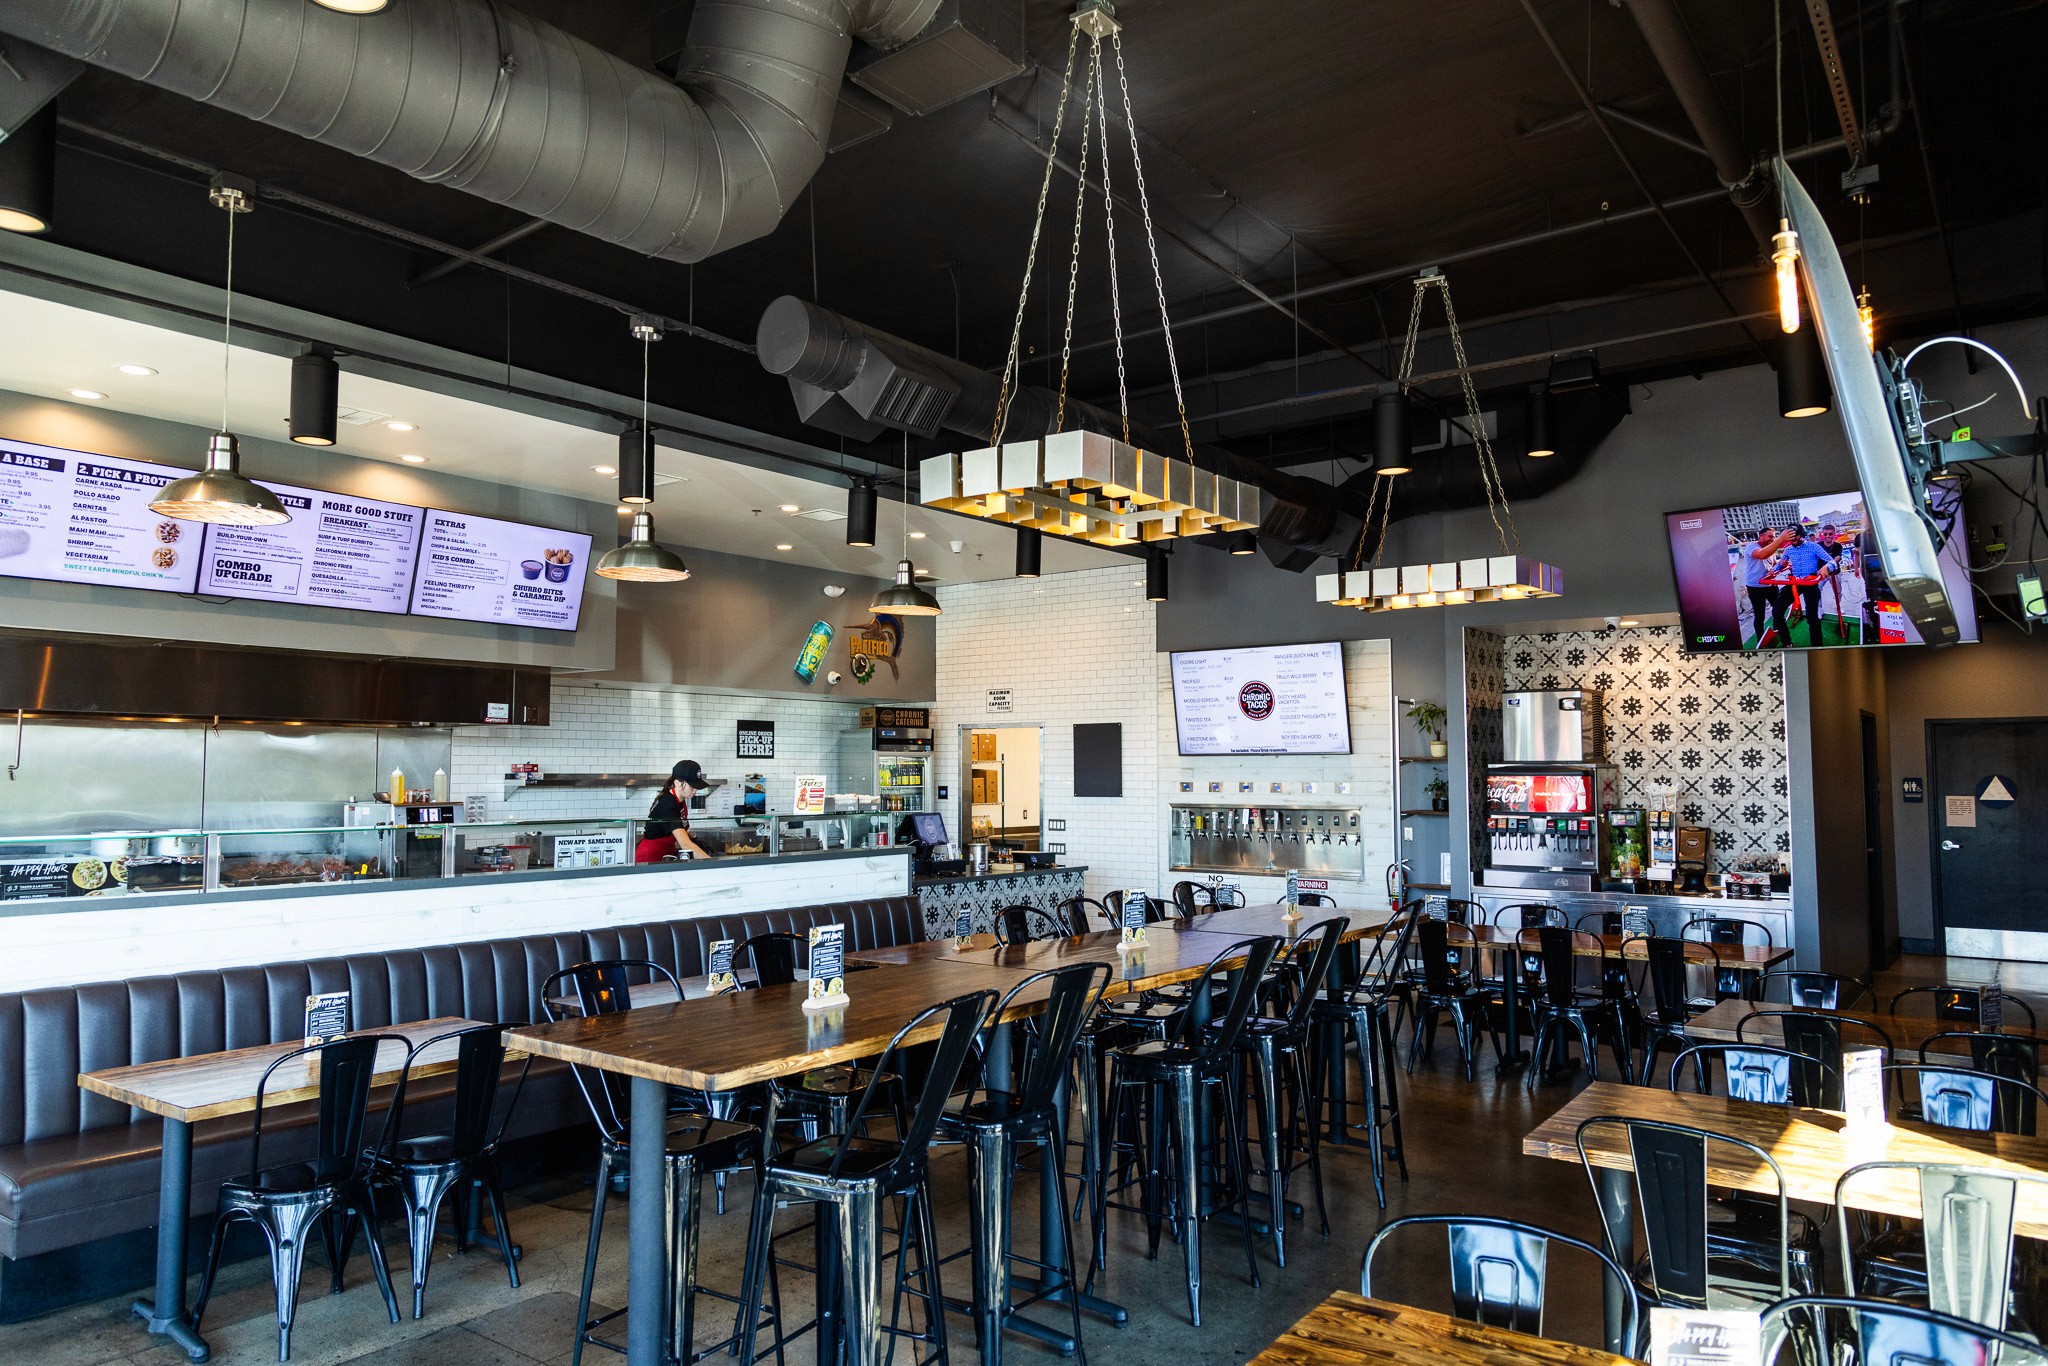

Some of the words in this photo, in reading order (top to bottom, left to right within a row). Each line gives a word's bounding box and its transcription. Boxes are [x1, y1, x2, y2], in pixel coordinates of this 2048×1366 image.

[2, 453, 12, 463] A
[14, 454, 49, 468] BASE
[78, 465, 89, 474] 2.
[92, 467, 121, 479] PICK
[123, 472, 132, 481] A
[135, 474, 172, 486] PROT
[73, 503, 107, 511] CARNITAS
[322, 501, 352, 513] MORE
[355, 506, 381, 517] GOOD
[384, 511, 414, 522] STUFF
[324, 516, 368, 528] BREAKFAST
[435, 519, 466, 529] EXTRAS
[217, 532, 267, 543] BUILD-YOUR-OWN
[65, 551, 108, 560] VEGETARIAN
[316, 547, 347, 555] CALIFORNIA
[216, 560, 261, 572] COMBO
[215, 568, 272, 583] UPGRADE
[514, 585, 542, 593] CHURRO
[543, 588, 563, 596] BITES
[519, 592, 552, 601] CARAMEL
[850, 636, 890, 658] PACIFICO
[1242, 693, 1270, 701] CHRONIC
[1246, 700, 1267, 709] TACOS
[739, 736, 773, 744] PICK-UP
[739, 744, 772, 755] HERE
[10, 864, 43, 877] HAPPY
[43, 864, 69, 875] HOUR
